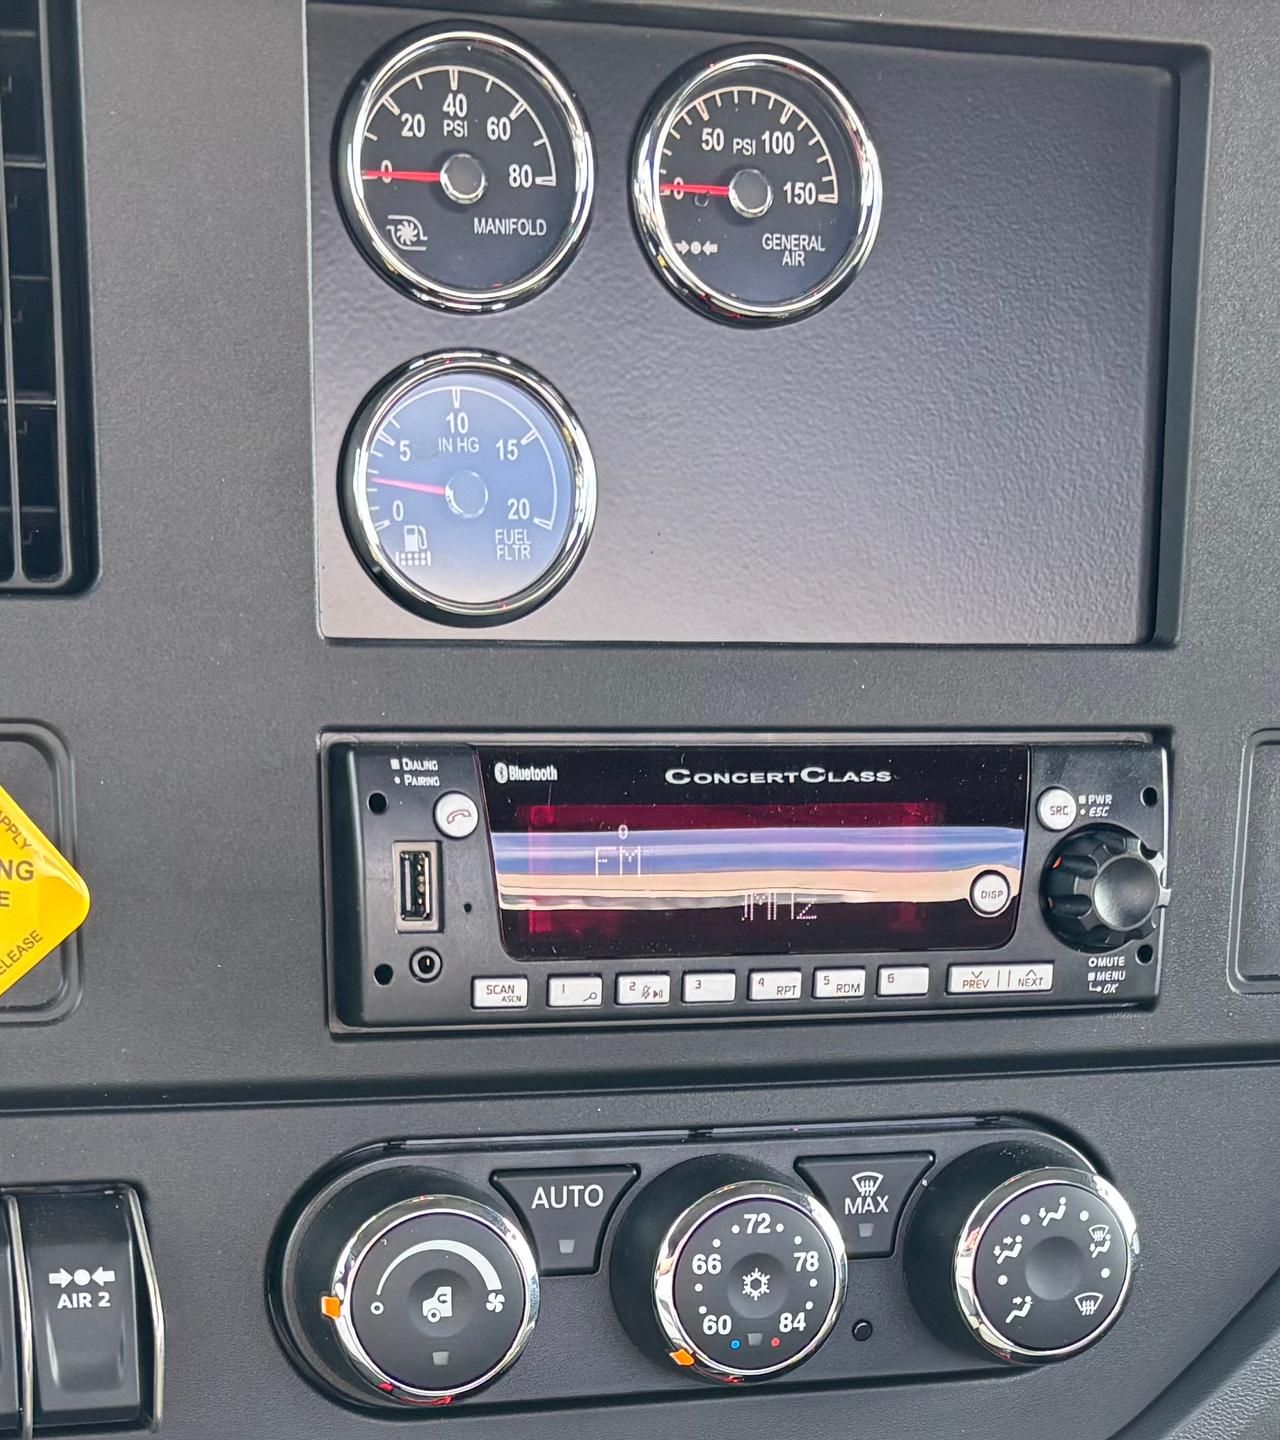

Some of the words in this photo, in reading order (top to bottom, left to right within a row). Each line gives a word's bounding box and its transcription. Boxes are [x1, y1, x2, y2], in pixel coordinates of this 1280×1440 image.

[443, 94, 468, 118] 40
[401, 113, 426, 138] 20
[442, 119, 468, 138] PSI
[486, 117, 511, 141] 60
[701, 128, 724, 152] 50
[733, 138, 757, 156] PSI
[762, 131, 795, 155] 100
[509, 164, 533, 188] 80
[784, 182, 816, 206] 150
[473, 218, 547, 236] MANIFOLD
[762, 233, 825, 252] GENERAL
[782, 249, 805, 267] AIR
[446, 412, 469, 433] 10
[399, 440, 411, 462] 5
[438, 437, 453, 453] IN
[457, 437, 480, 453] HG
[496, 440, 518, 461] 15
[392, 501, 404, 522] 0
[507, 498, 530, 520] 20
[495, 529, 532, 545] FUEL
[496, 545, 531, 560] FLTR
[508, 765, 558, 781] Bluetooth
[1088, 794, 1112, 805] PWR
[1050, 805, 1069, 816] SRC
[1089, 806, 1110, 817] ESC
[595, 846, 641, 878] FM
[981, 890, 1003, 900] DISP
[1098, 956, 1125, 967] MUTE
[694, 980, 702, 990] 3
[758, 978, 765, 988] 4
[823, 976, 830, 985] 5
[887, 974, 895, 983] 6
[962, 979, 990, 989] PREV
[1018, 977, 1043, 988] NEXT
[1096, 970, 1126, 982] MENU
[486, 984, 515, 995] SCAN
[629, 982, 637, 991] 2
[776, 985, 797, 996] RPT
[836, 983, 861, 994] RDM
[1103, 983, 1119, 994] OK
[531, 1184, 604, 1209] AUTO
[844, 1195, 889, 1216] MAX
[744, 1213, 771, 1235] 72
[692, 1254, 722, 1275] 66
[793, 1252, 819, 1273] 78
[57, 1292, 93, 1310] AIR
[98, 1291, 111, 1309] 2
[703, 1314, 732, 1335] 60
[779, 1312, 806, 1333] 84
